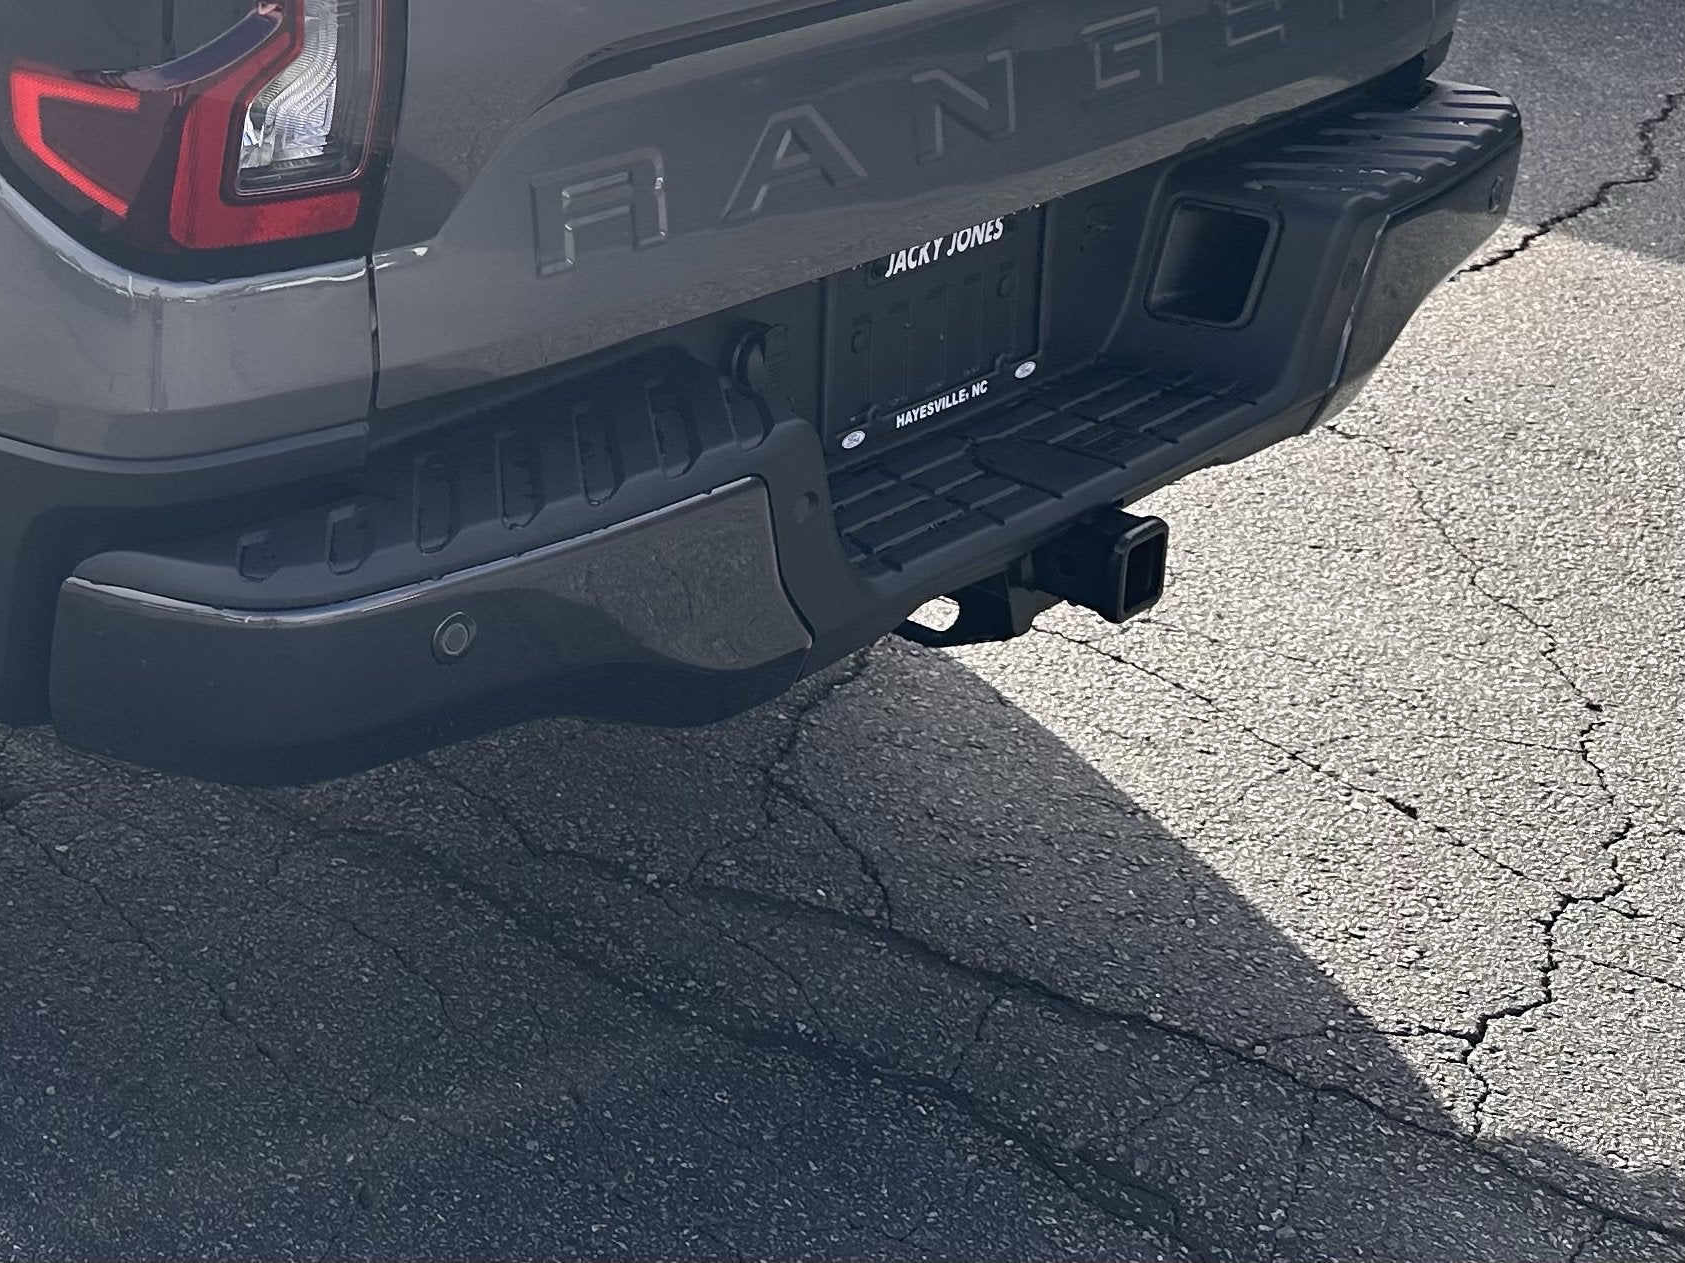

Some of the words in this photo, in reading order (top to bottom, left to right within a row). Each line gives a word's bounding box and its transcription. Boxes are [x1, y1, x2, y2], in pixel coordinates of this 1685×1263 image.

[884, 237, 944, 278] JACKY
[946, 216, 1005, 257] JONES
[895, 388, 970, 429] HAYESVILLE,
[971, 380, 989, 398] NC
